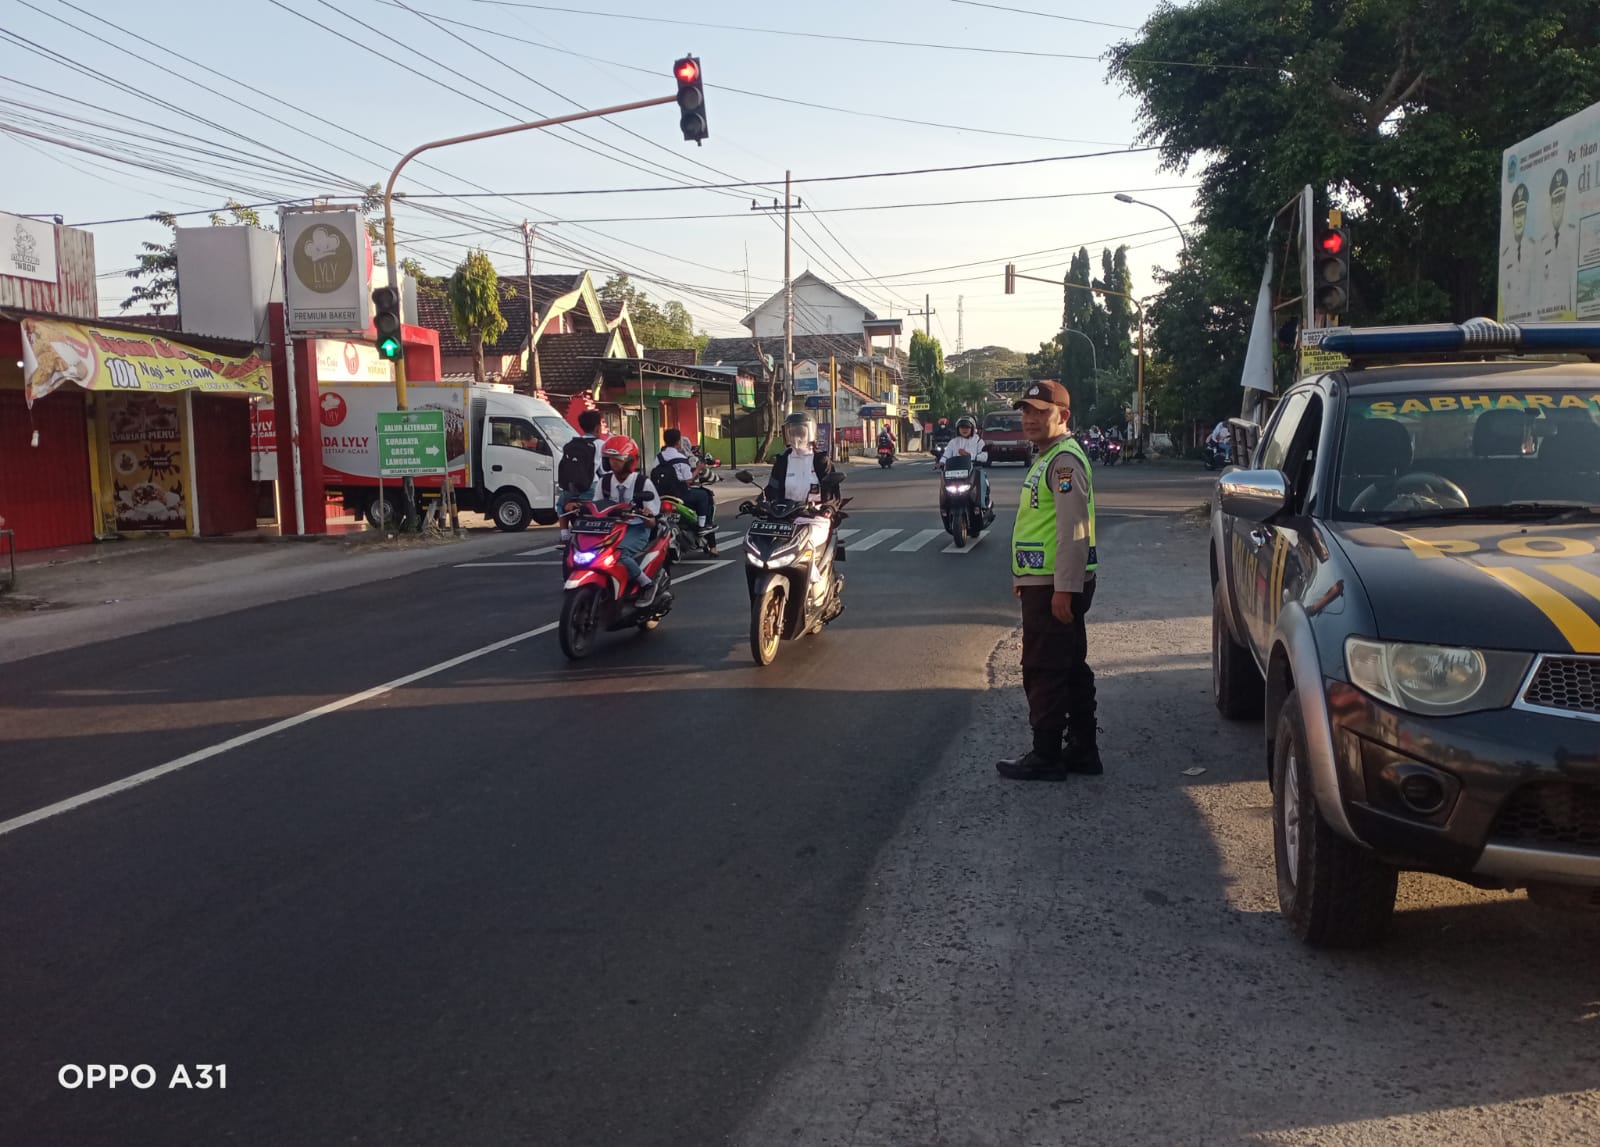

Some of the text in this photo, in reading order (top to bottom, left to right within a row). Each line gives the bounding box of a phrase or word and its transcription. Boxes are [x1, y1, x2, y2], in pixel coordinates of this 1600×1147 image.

[1567, 142, 1598, 164] Patikan
[313, 262, 339, 284] LYLY
[294, 309, 356, 321] PREMIUM BAKERY
[1369, 394, 1589, 415] SABHARA
[342, 436, 370, 448] LYLY
[1401, 536, 1600, 559] PO
